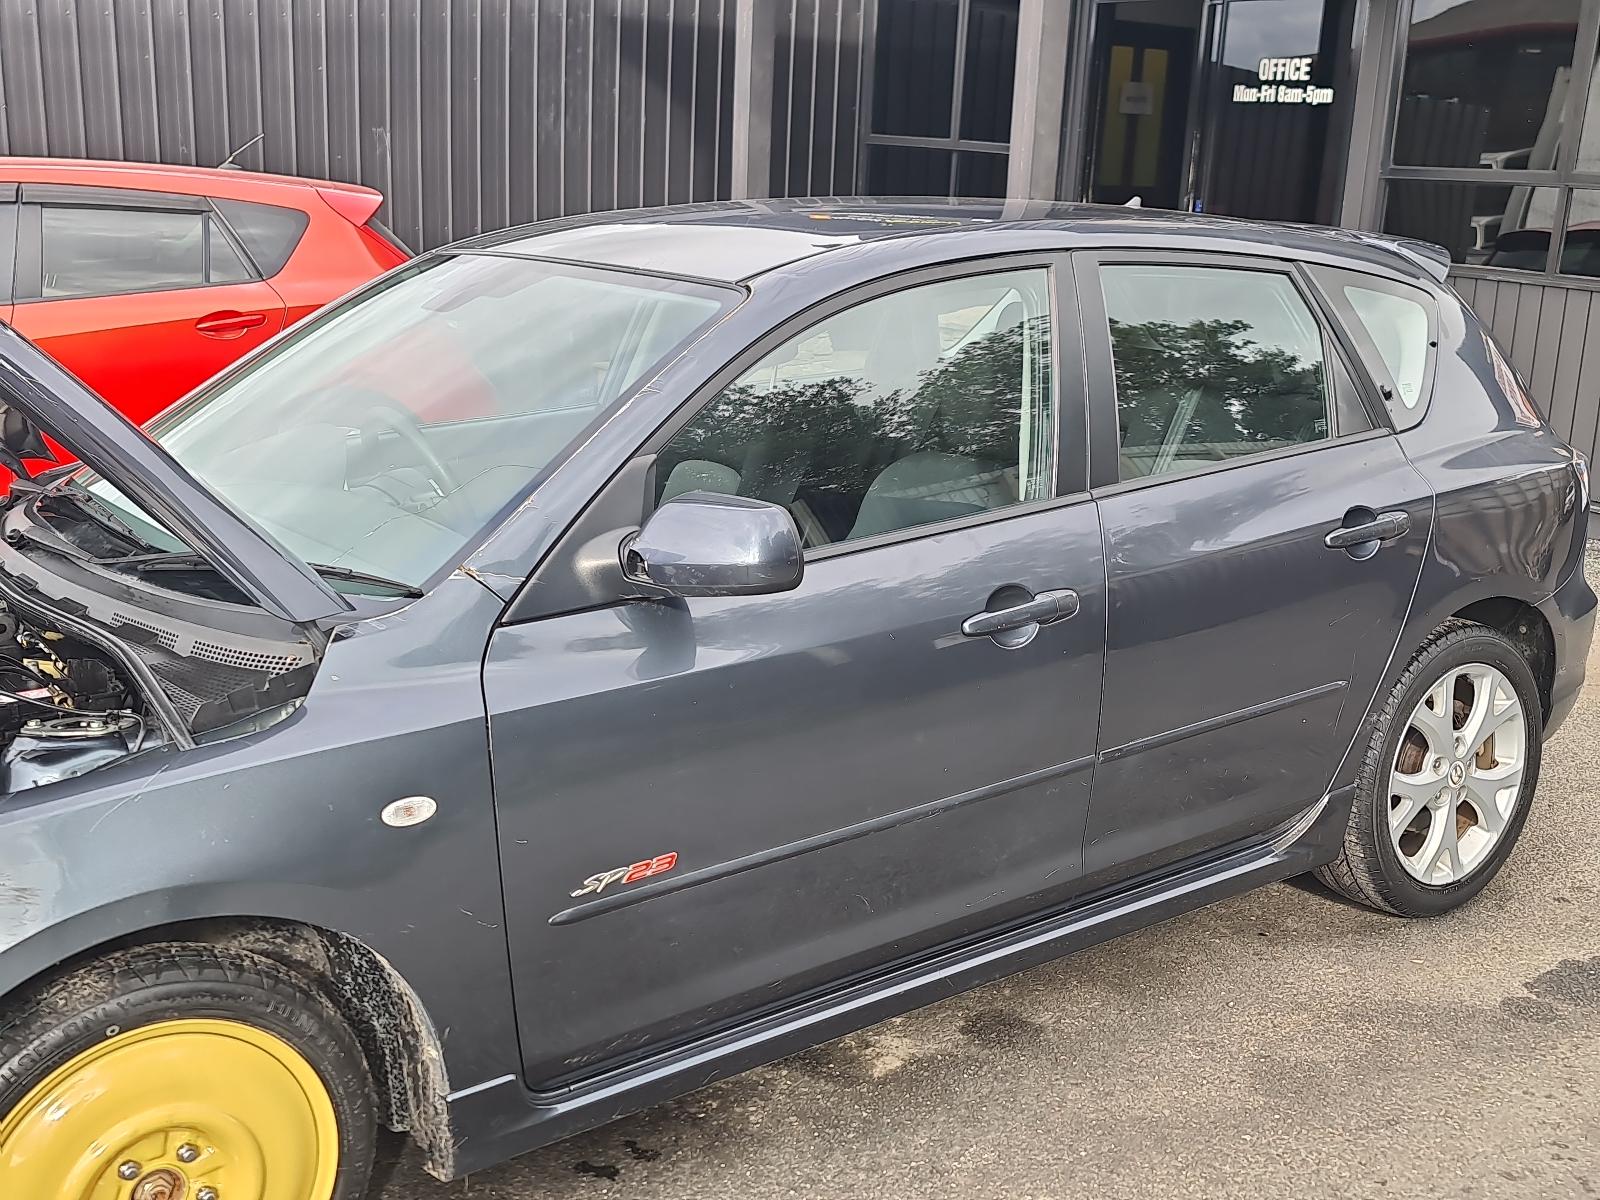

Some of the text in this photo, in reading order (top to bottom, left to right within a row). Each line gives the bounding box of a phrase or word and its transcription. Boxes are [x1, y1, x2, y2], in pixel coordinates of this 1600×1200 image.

[1258, 58, 1312, 81] OFFICE
[1233, 84, 1334, 105] Mon-Fri 8am-5pm
[570, 851, 678, 897] SP23
